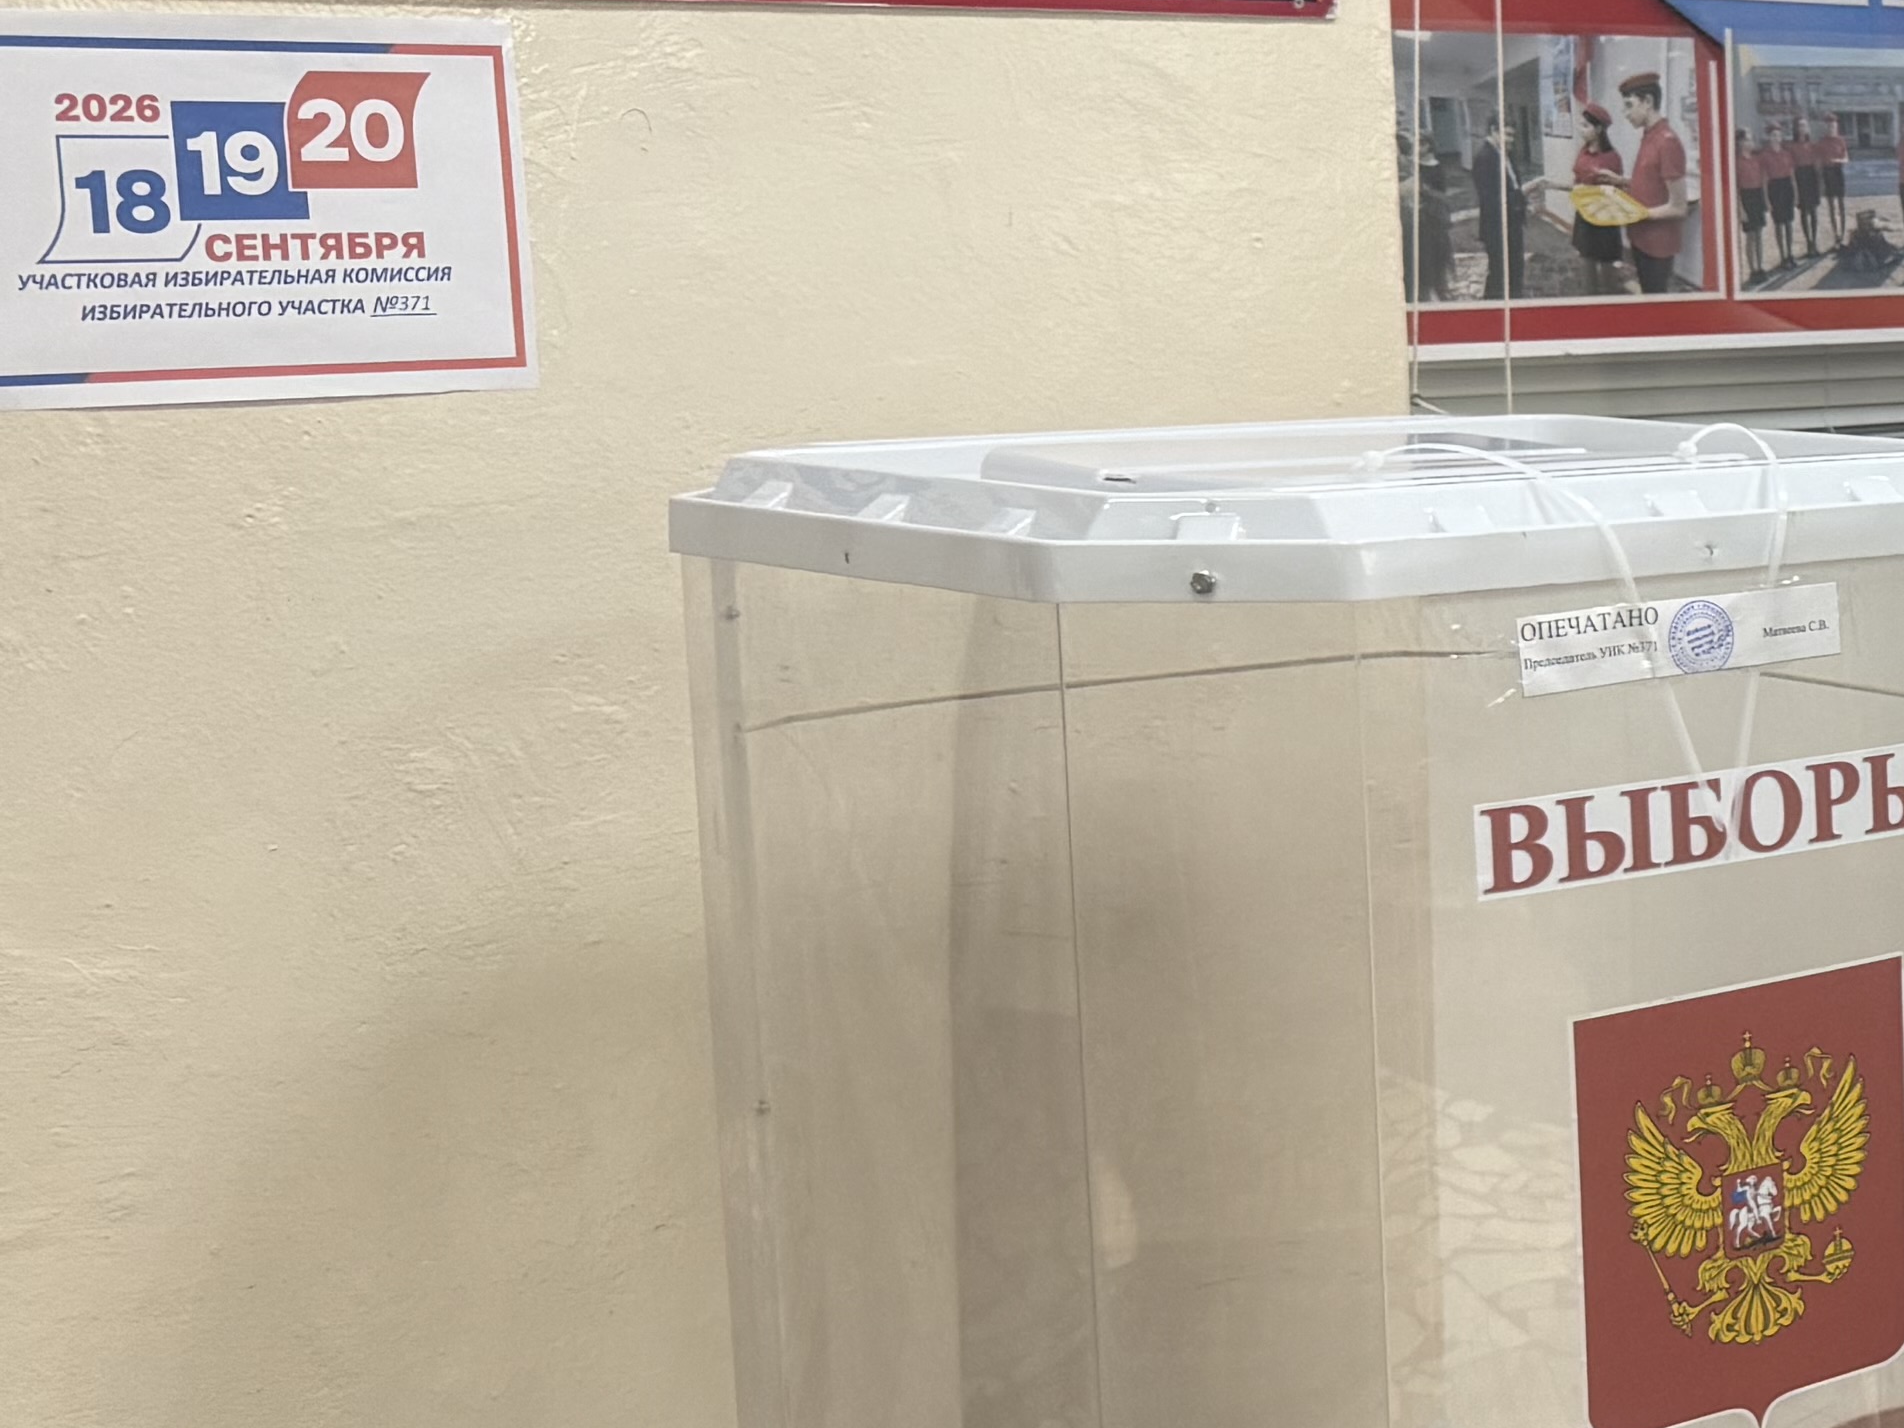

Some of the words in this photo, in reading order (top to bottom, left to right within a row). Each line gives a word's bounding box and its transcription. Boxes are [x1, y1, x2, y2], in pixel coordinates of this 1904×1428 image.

[55, 93, 160, 122] 2026
[75, 169, 171, 234] 18
[187, 131, 278, 195] 19
[297, 98, 403, 162] 20
[205, 232, 425, 262] СЕНТЯБРЯ
[18, 273, 156, 291] УЧАСТКОВАЯ
[164, 269, 336, 288] ИЗБИРАТЕЛЬНАЯ
[342, 266, 451, 284] КОМИССИЯ
[81, 300, 272, 321] ИЗБИРАТЕЛЬНОГО
[278, 298, 365, 317] УЧАСТКА
[372, 295, 431, 314] №371
[1520, 606, 1658, 642] ОПЕЧАТАНО
